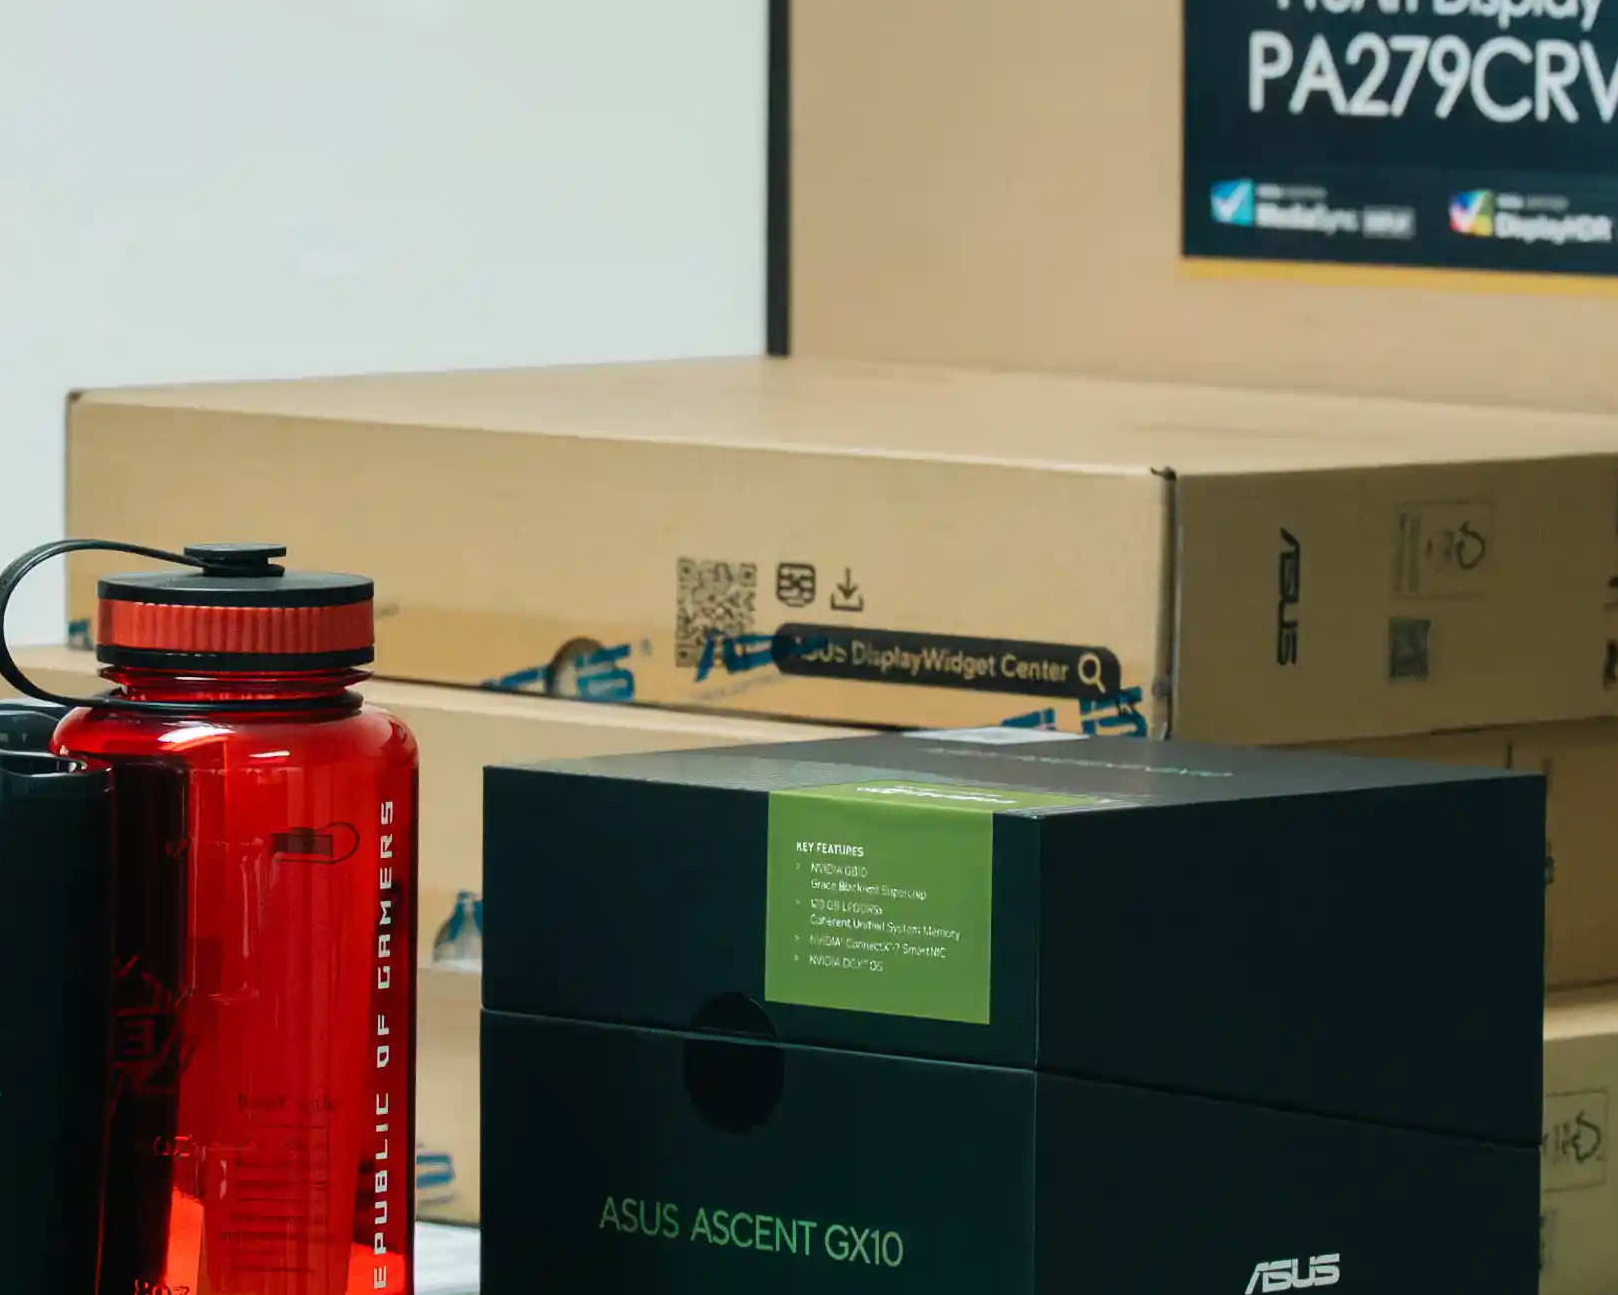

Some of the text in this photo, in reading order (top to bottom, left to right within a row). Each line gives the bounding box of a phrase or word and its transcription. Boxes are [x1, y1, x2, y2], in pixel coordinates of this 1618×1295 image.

[1278, 528, 1301, 666] ASUS
[851, 640, 996, 682] DisplayWidget
[1000, 653, 1069, 683] Center
[796, 841, 864, 857] KEY FEATURES
[377, 801, 394, 990] GAMERS
[377, 1014, 390, 1068] OF
[598, 1195, 904, 1267] ASUS ASCENT GX10
[1245, 1253, 1341, 1295] ASUS
